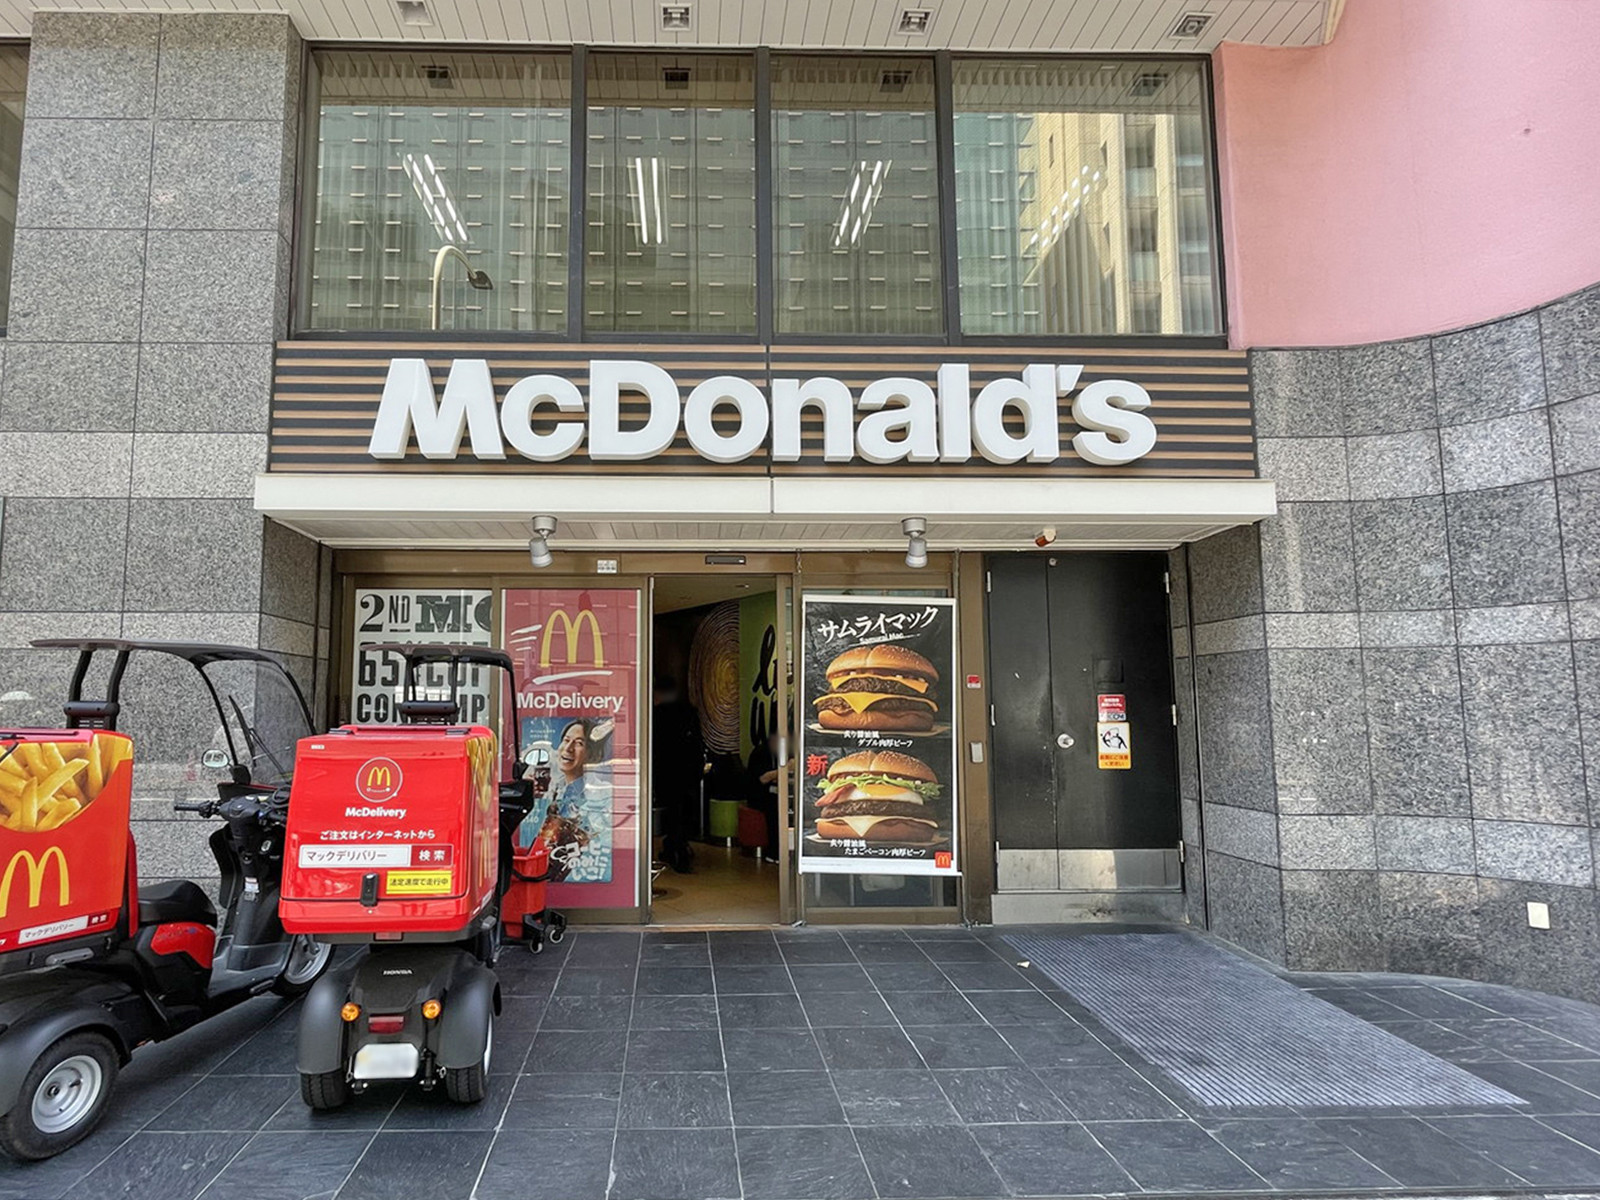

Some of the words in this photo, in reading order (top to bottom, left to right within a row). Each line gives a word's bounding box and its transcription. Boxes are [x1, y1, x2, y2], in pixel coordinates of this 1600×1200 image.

[368, 357, 1158, 467] McDonald's
[817, 605, 939, 643] サムライマック
[516, 692, 624, 712] McDelivery
[806, 754, 828, 776] 新
[345, 807, 406, 819] McDelivery
[320, 830, 435, 841] ご注文はインターネットから
[306, 850, 387, 862] マックデリバリー
